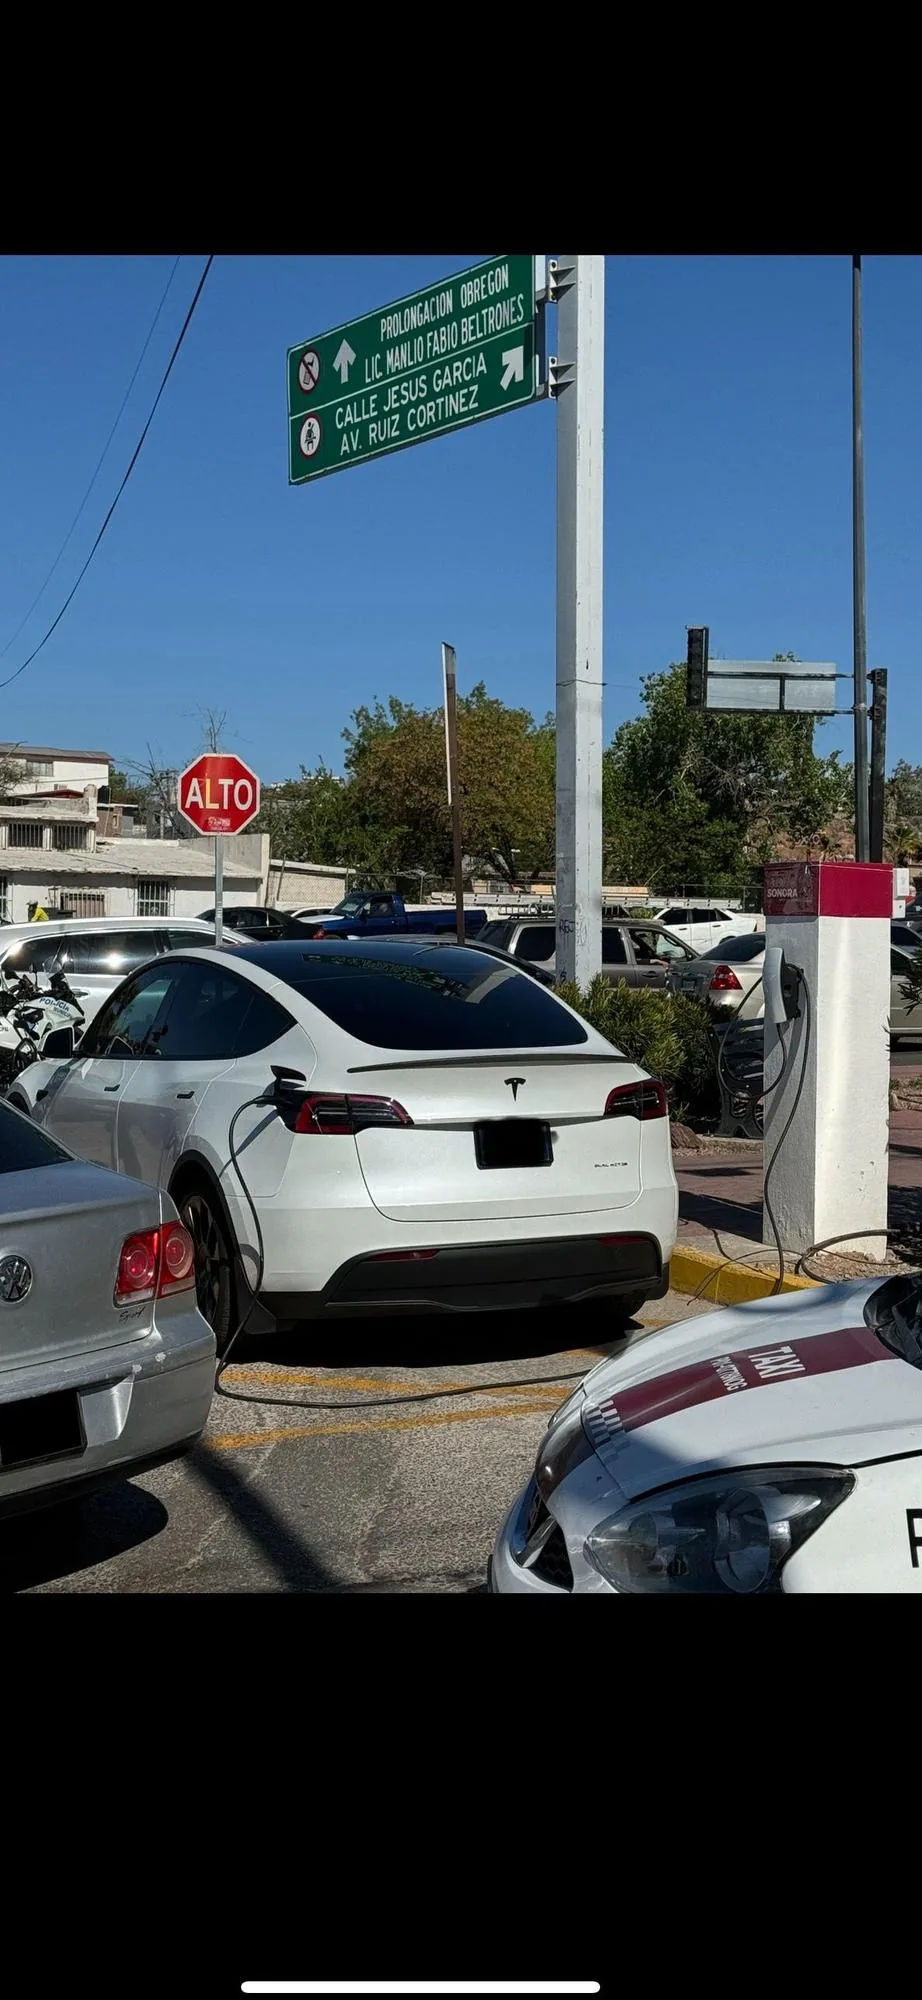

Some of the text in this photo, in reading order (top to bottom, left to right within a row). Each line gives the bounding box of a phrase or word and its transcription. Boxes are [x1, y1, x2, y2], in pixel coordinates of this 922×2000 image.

[364, 293, 525, 384] LIC. MANLIO FABIO BELTRONES
[380, 263, 510, 342] PROLONGACION OBREGON
[335, 352, 488, 430] CALLE JESUS GARCIA
[340, 384, 479, 456] AV. RUIZ CORTINEZ
[185, 777, 253, 811] ALTO
[767, 888, 799, 898] SONORA
[748, 1345, 806, 1379] TAXI
